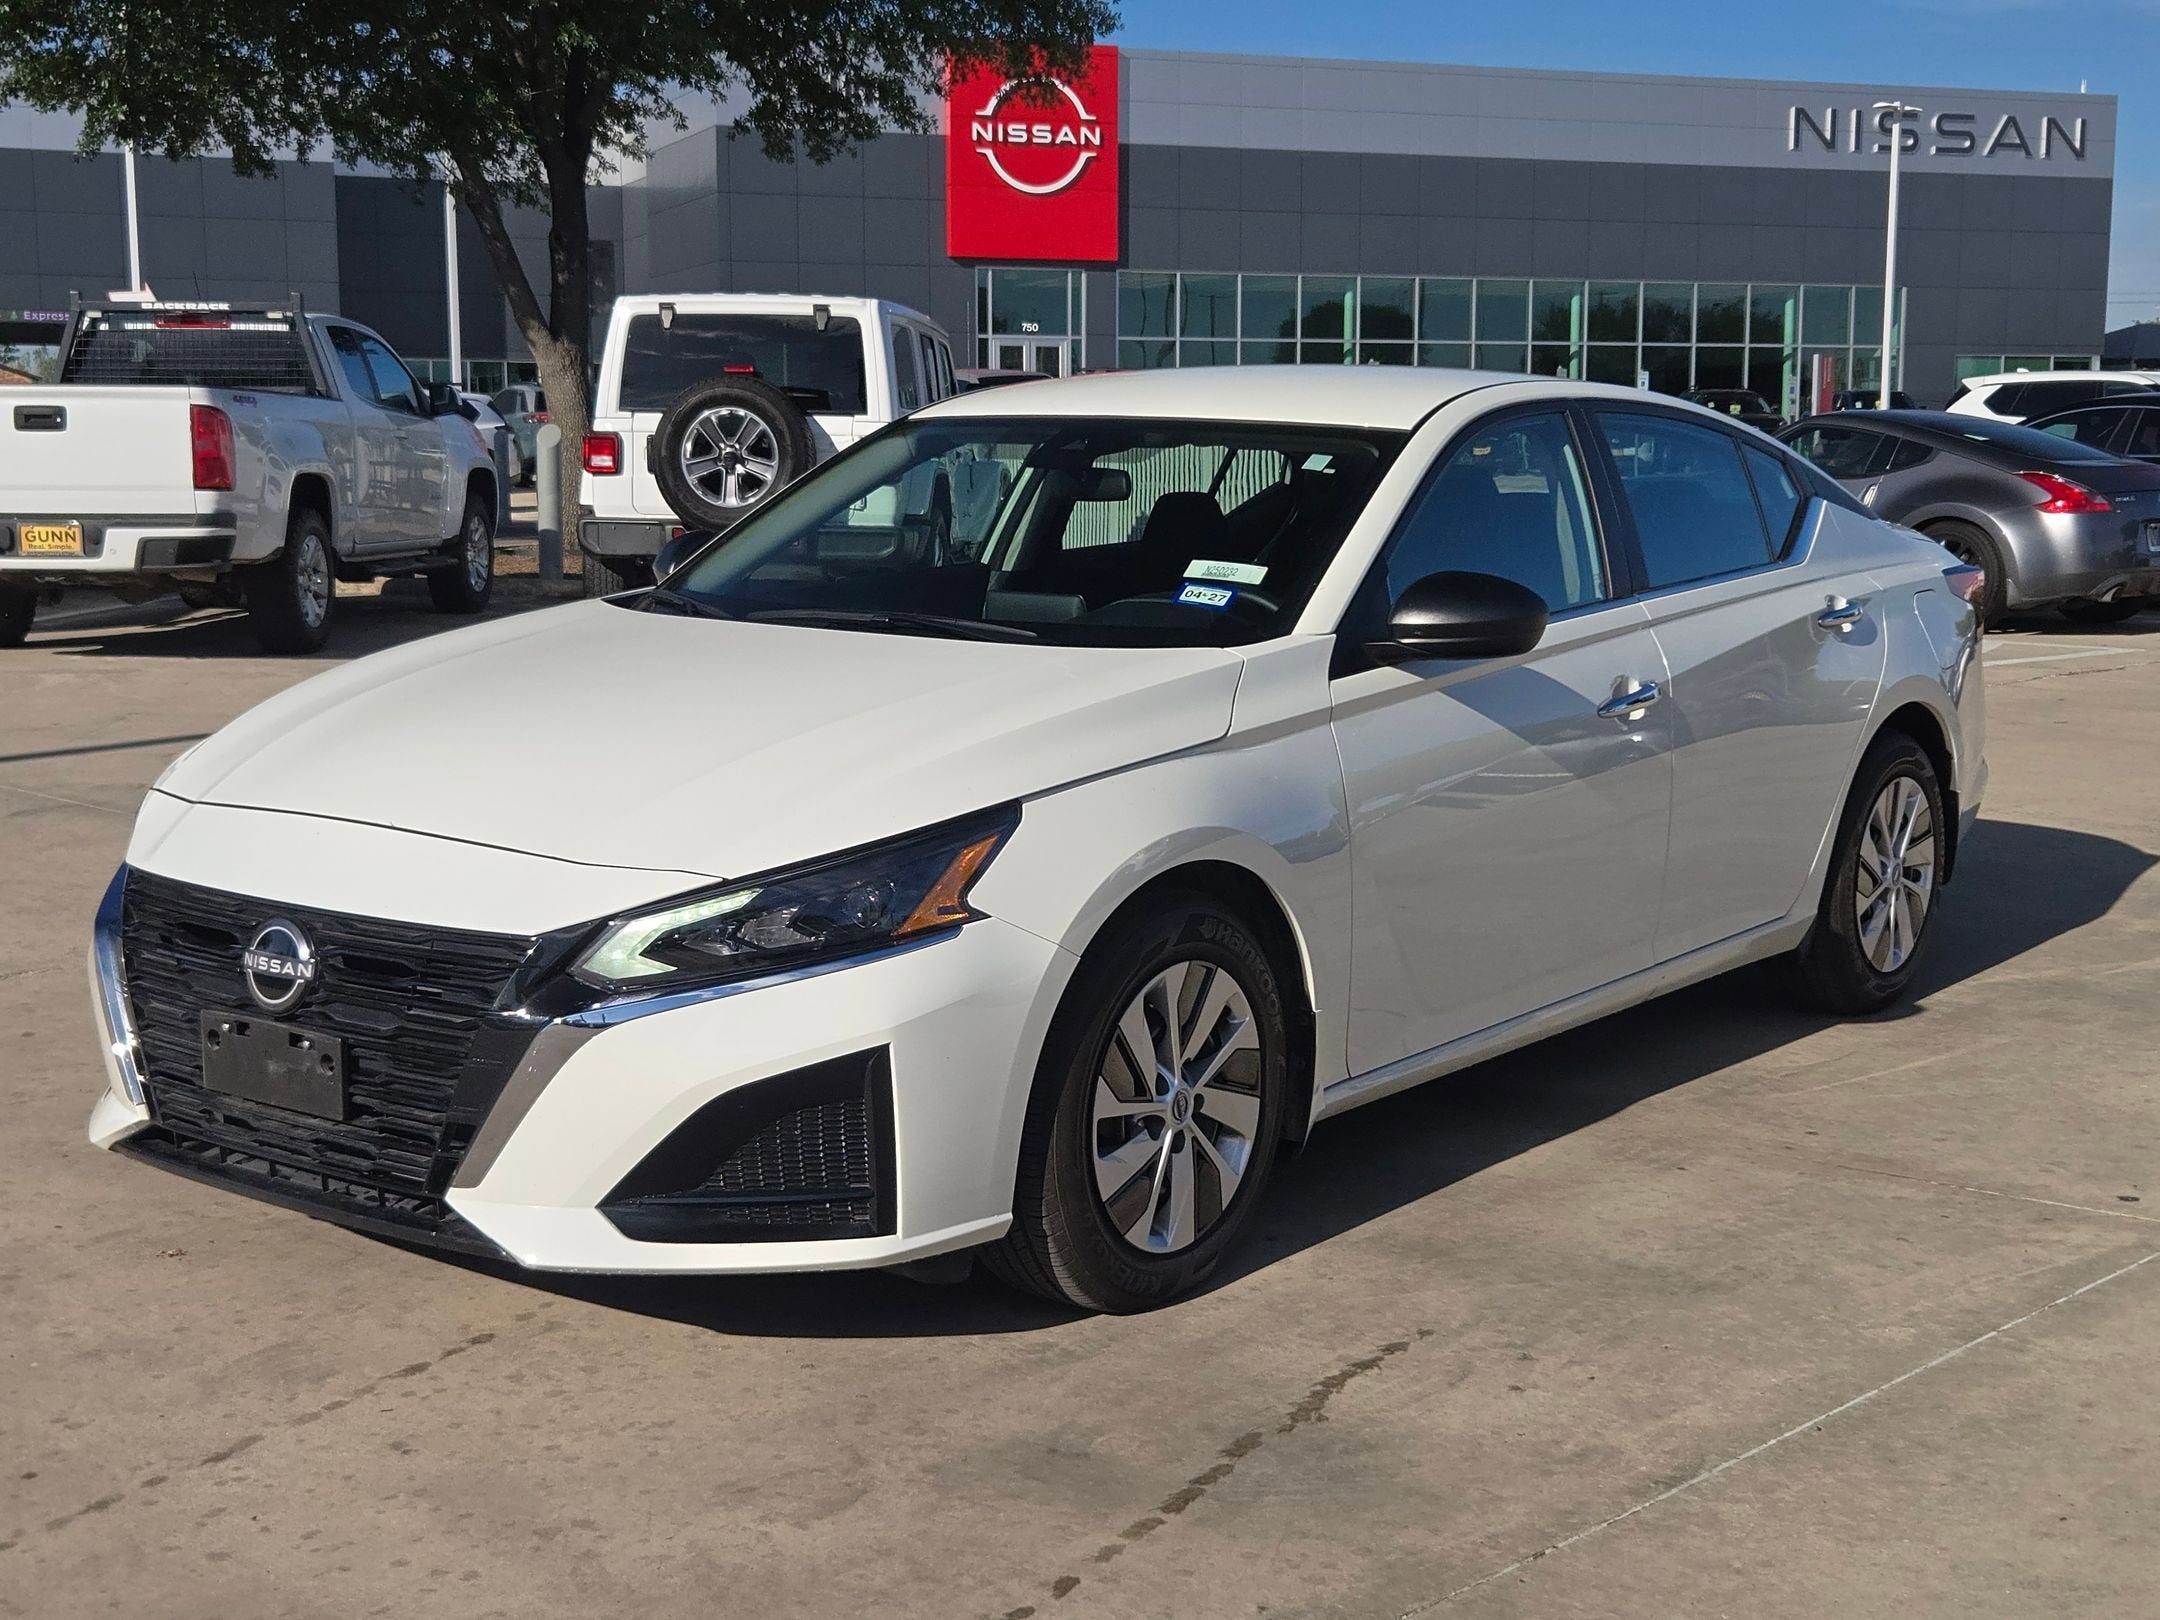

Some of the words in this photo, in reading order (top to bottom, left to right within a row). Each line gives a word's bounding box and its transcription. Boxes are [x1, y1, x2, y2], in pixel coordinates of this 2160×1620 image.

[972, 121, 1100, 146] NISSAN
[1789, 106, 2087, 159] NISSAN
[141, 302, 231, 310] BACKRACK
[1021, 323, 1039, 332] 750
[25, 530, 77, 543] GUNN
[244, 951, 313, 978] NISSAN
